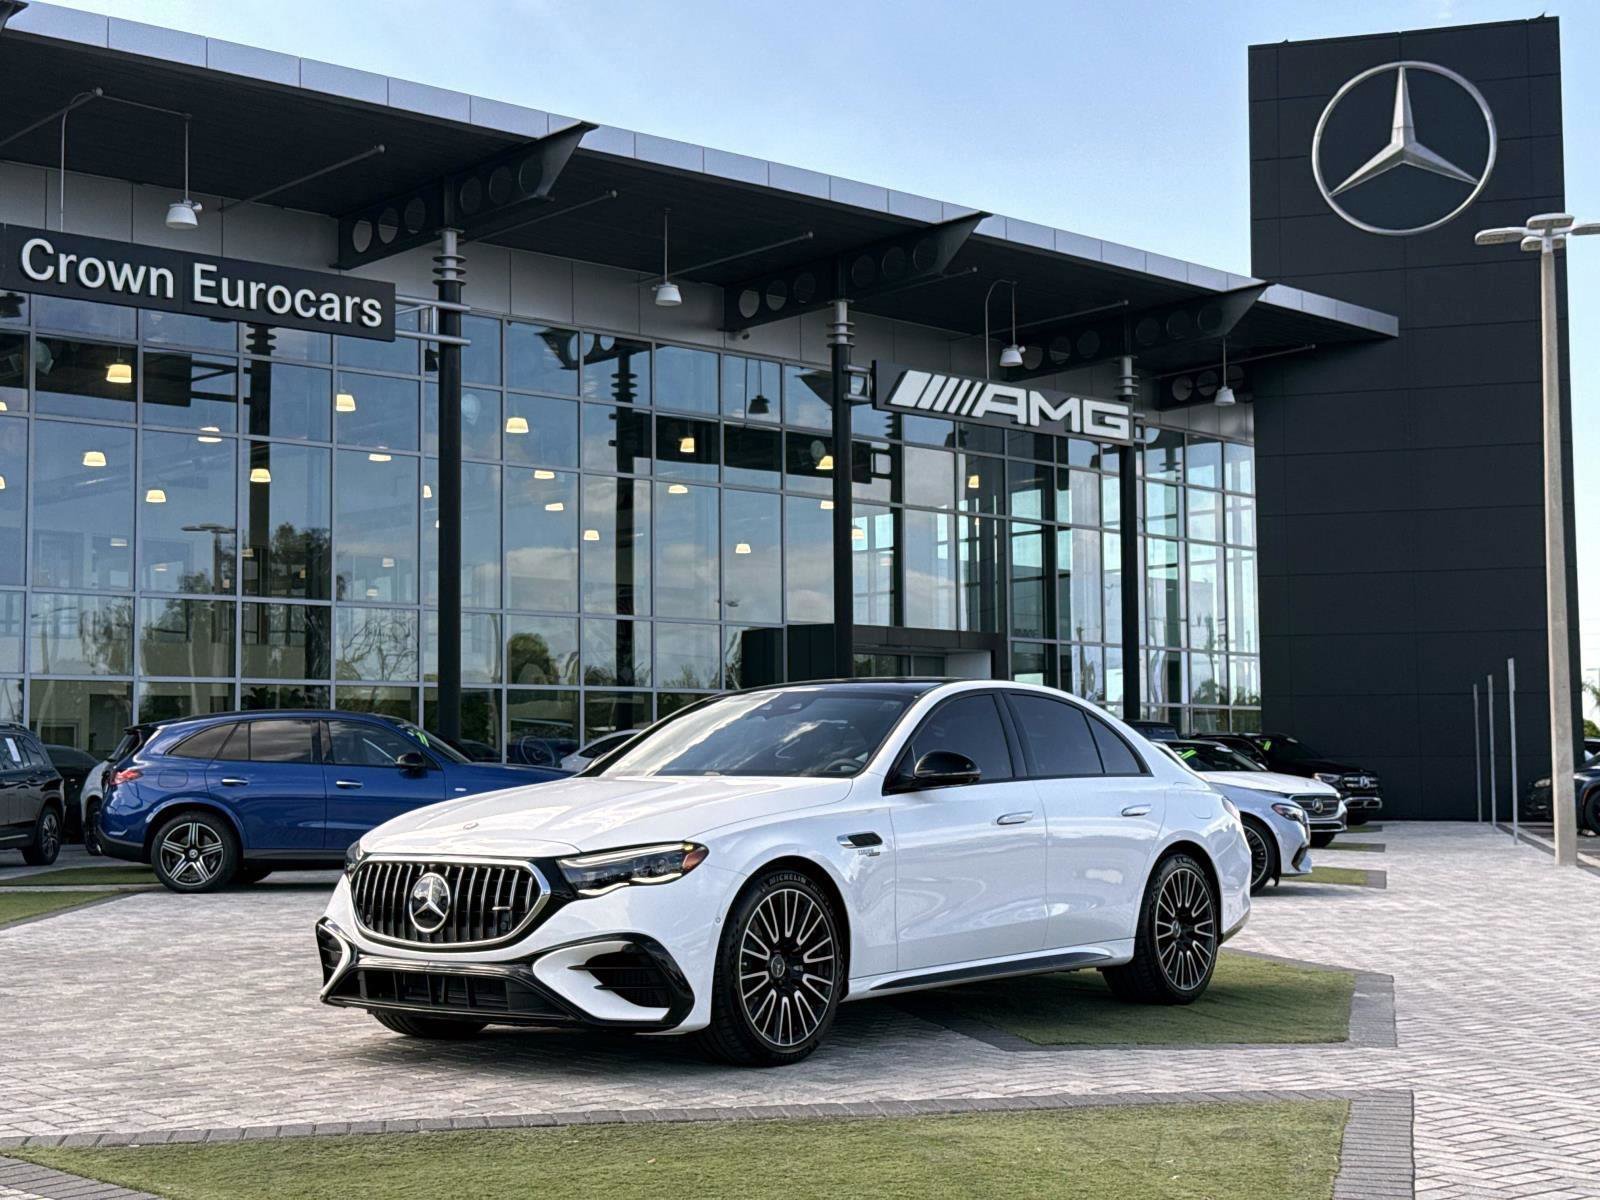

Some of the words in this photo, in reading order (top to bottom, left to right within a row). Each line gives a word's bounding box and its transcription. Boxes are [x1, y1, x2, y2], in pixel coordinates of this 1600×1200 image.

[20, 238, 174, 298] Crown
[192, 262, 382, 328] Eurocars
[971, 382, 1130, 440] AMG
[769, 873, 807, 885] MICHELIN
